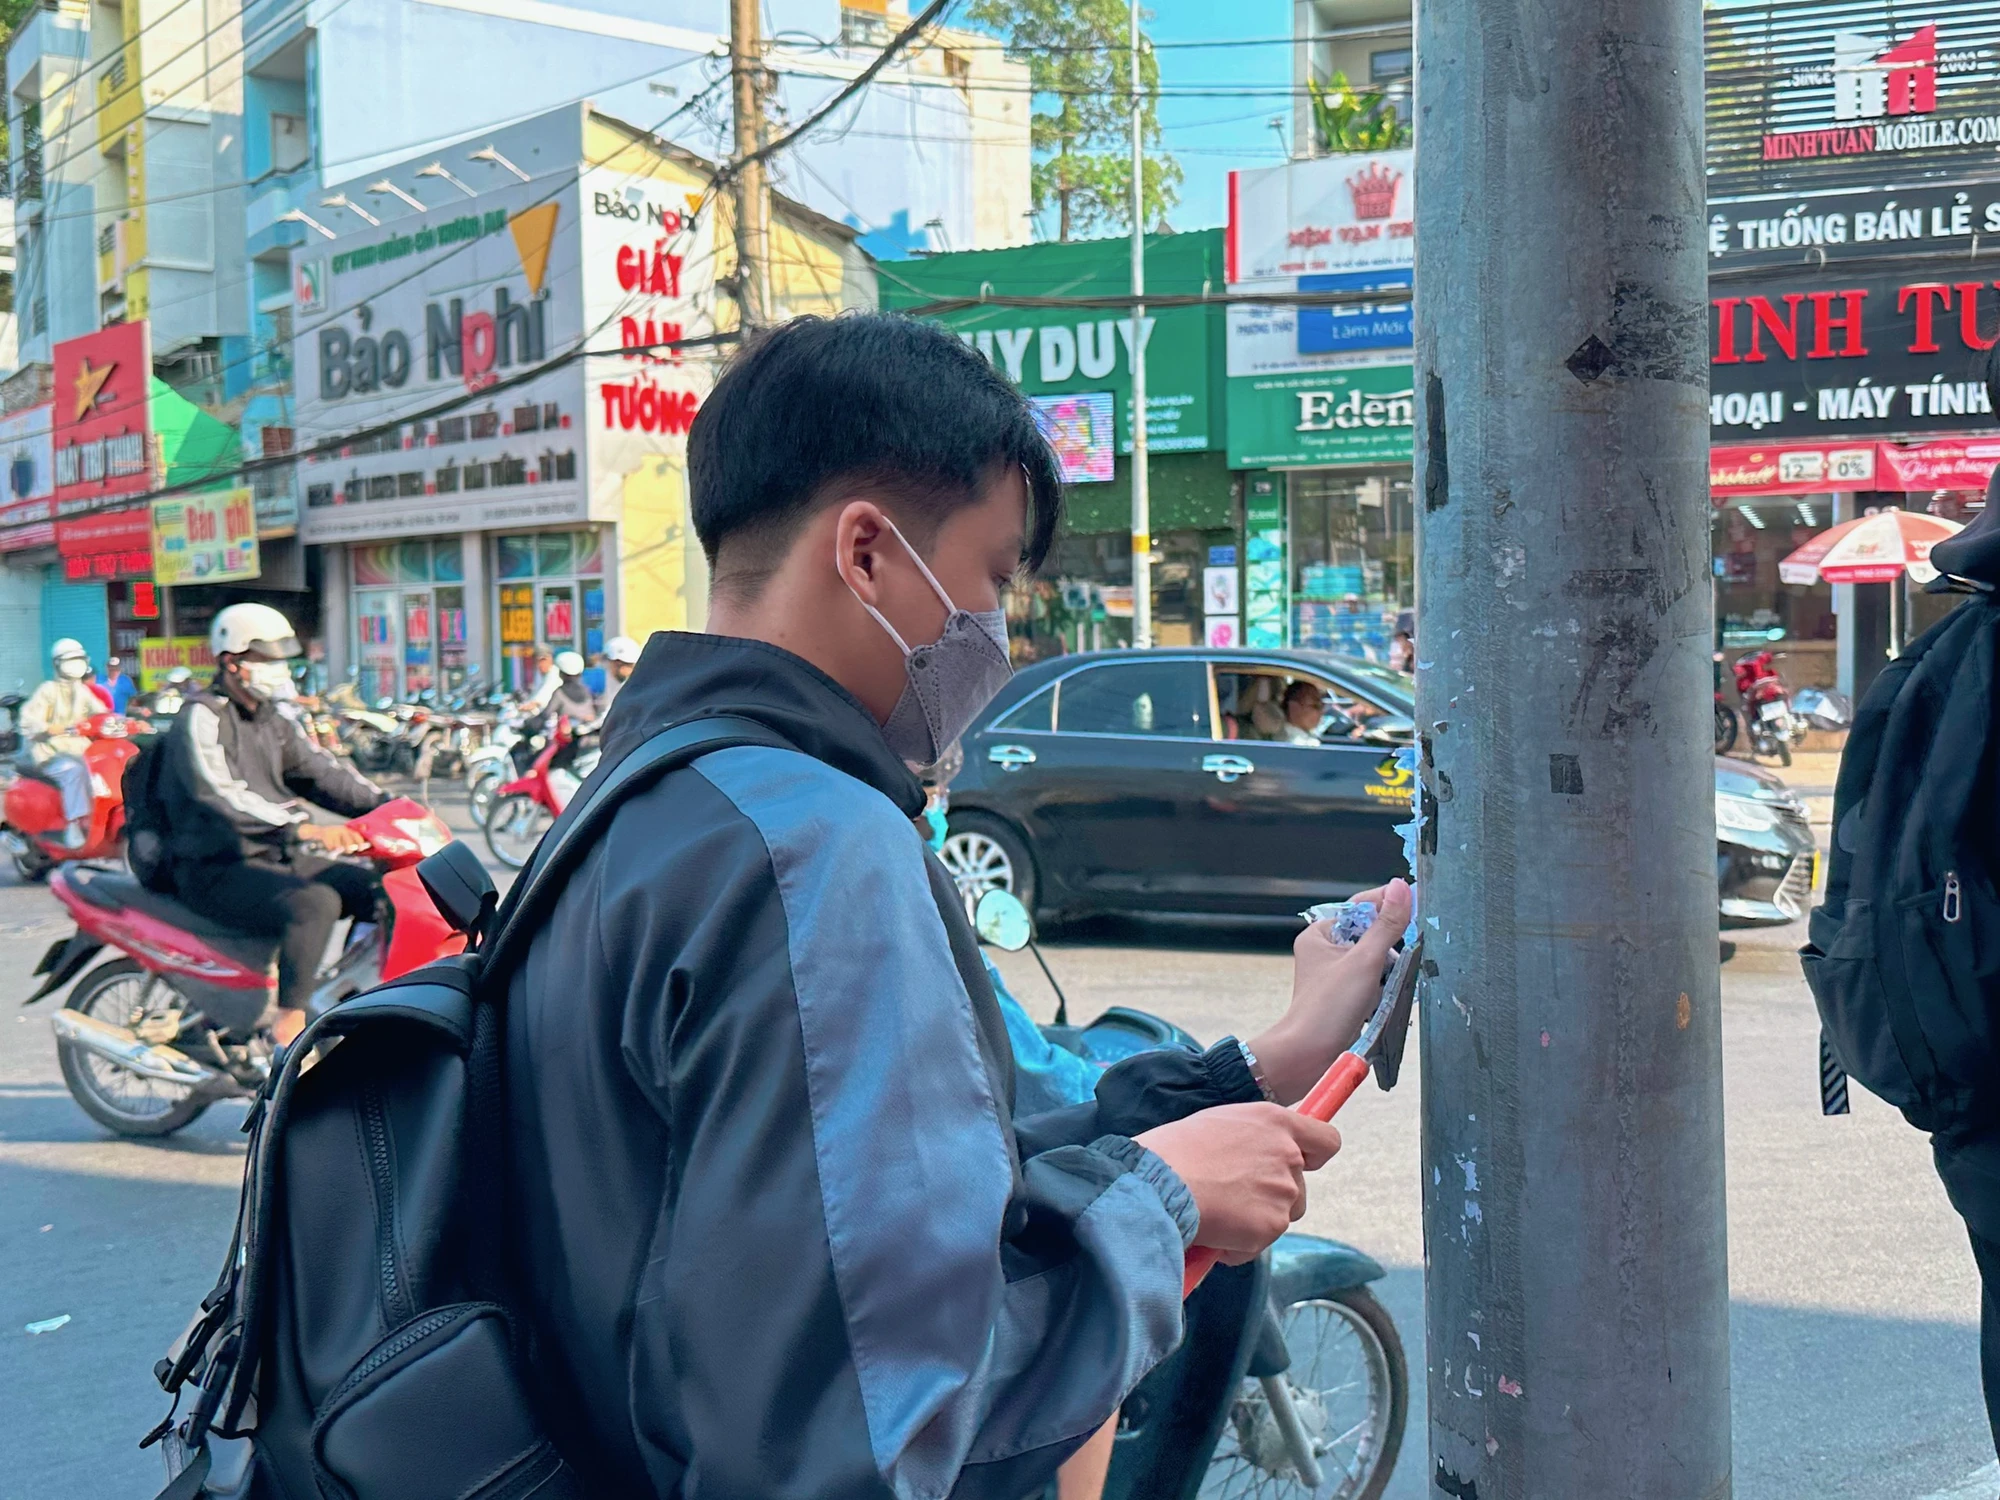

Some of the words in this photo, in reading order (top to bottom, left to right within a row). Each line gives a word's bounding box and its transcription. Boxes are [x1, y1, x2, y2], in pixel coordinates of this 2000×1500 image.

[1762, 116, 2000, 161] MINHTUANMOBILE.COM
[1738, 203, 1847, 250] THỐNG
[1855, 201, 1922, 242] BÁN
[1931, 191, 1973, 237] LẺ
[617, 237, 682, 298] GIẤY
[319, 304, 410, 399] Bảo
[622, 307, 683, 368] DÁN
[1039, 317, 1157, 383] DUY
[1711, 289, 1869, 364] INH
[601, 371, 699, 435] TƯỜNG
[1295, 389, 1413, 432] Eden
[1818, 377, 1897, 421] MÁY
[1905, 373, 1992, 417] TÍNH
[1837, 461, 1865, 477] 0%
